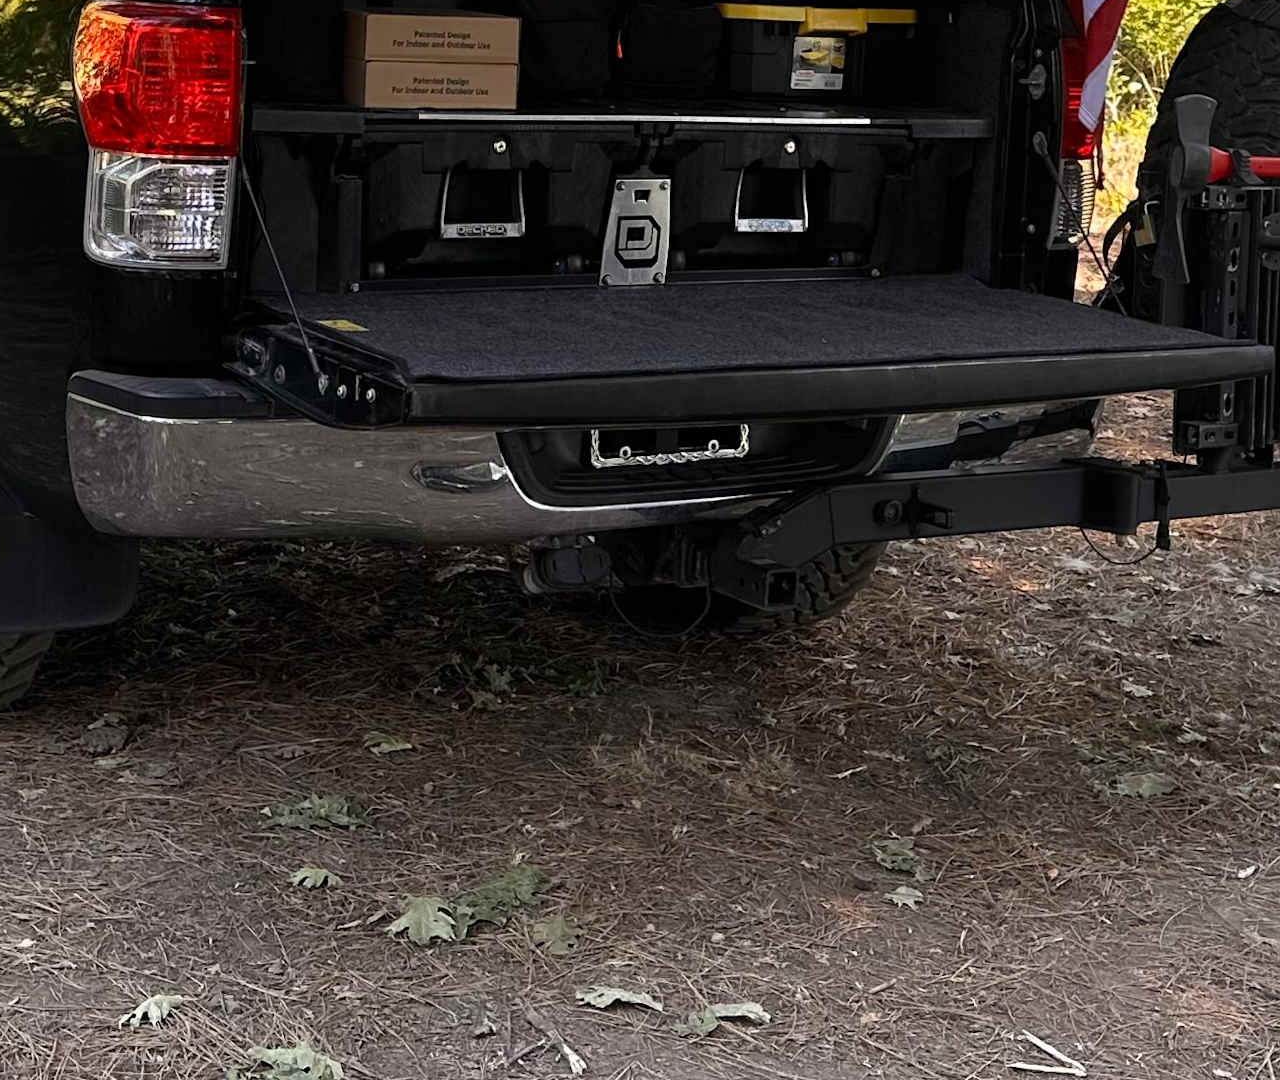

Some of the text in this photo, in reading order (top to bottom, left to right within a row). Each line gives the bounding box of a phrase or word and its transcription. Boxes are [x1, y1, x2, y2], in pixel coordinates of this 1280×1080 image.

[392, 39, 405, 48] For
[431, 40, 445, 48] and
[392, 86, 404, 94] For
[430, 87, 444, 95] and
